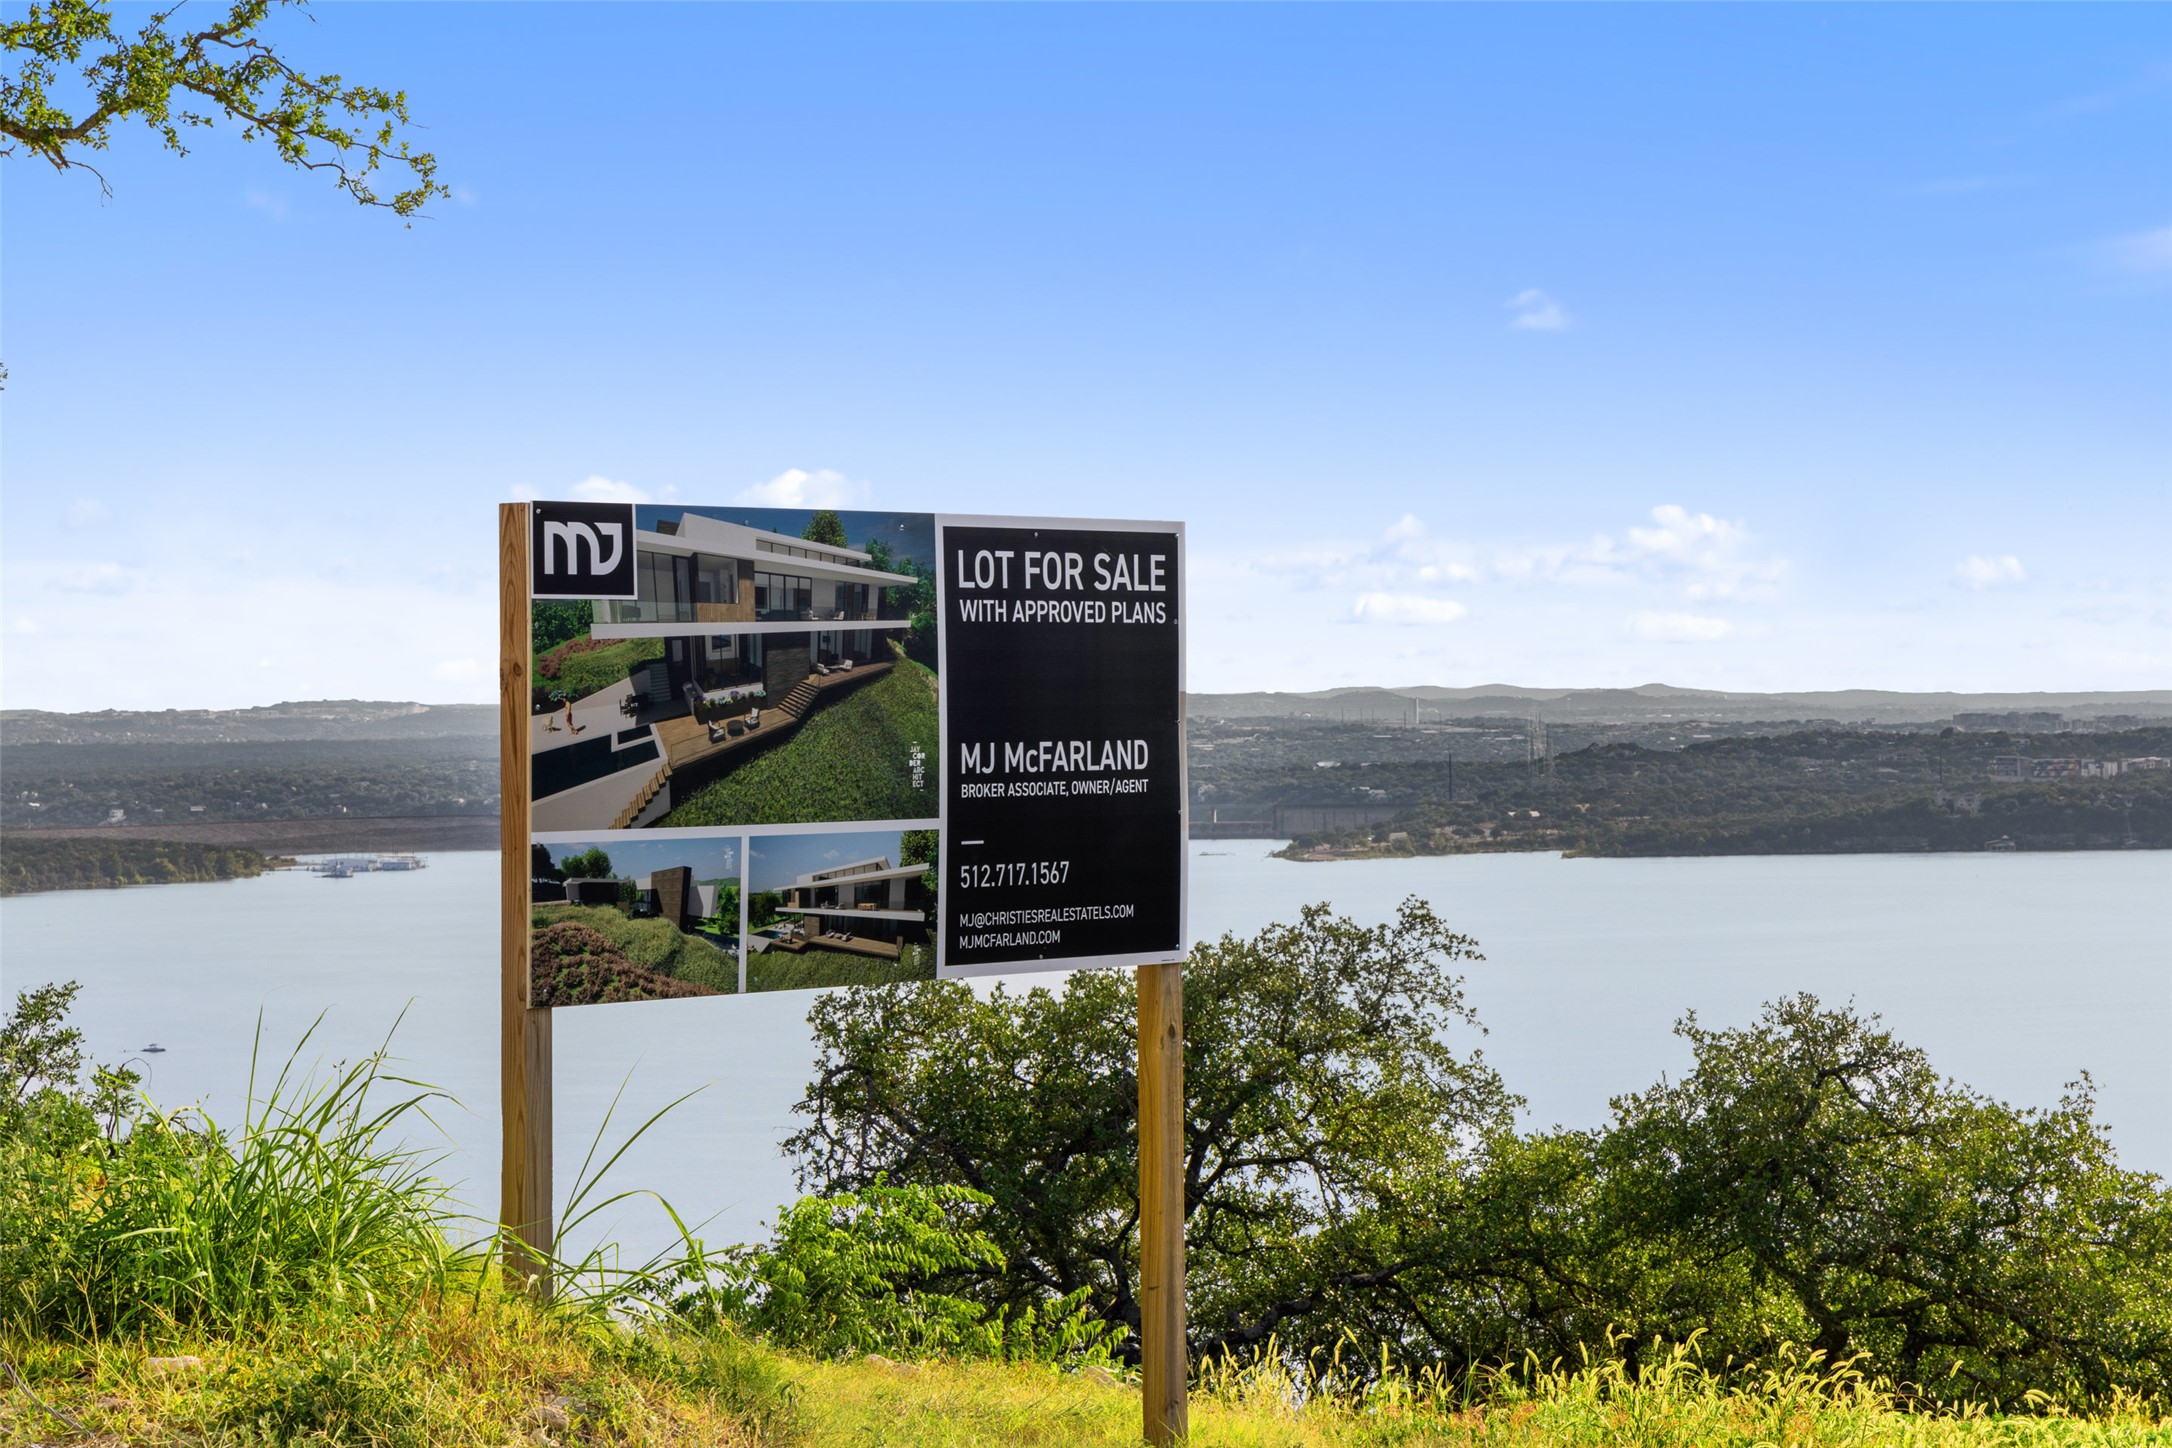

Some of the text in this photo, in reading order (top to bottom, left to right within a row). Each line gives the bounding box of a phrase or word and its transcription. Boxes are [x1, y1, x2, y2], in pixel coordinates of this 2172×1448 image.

[958, 550, 1166, 591] LOT FOR SALE
[959, 599, 1166, 624] WITH APPROVED PLANS
[962, 740, 1148, 774] MJ McFARLAND
[962, 778, 1148, 798] BROKER ASSOCIATE, OWNER/AGENT
[961, 861, 1069, 888] 512.717.1567
[960, 905, 1133, 928] MJ@CHRISTIESREALESTATELS.COM
[960, 930, 1060, 948] MJMCFARLAND.COM
